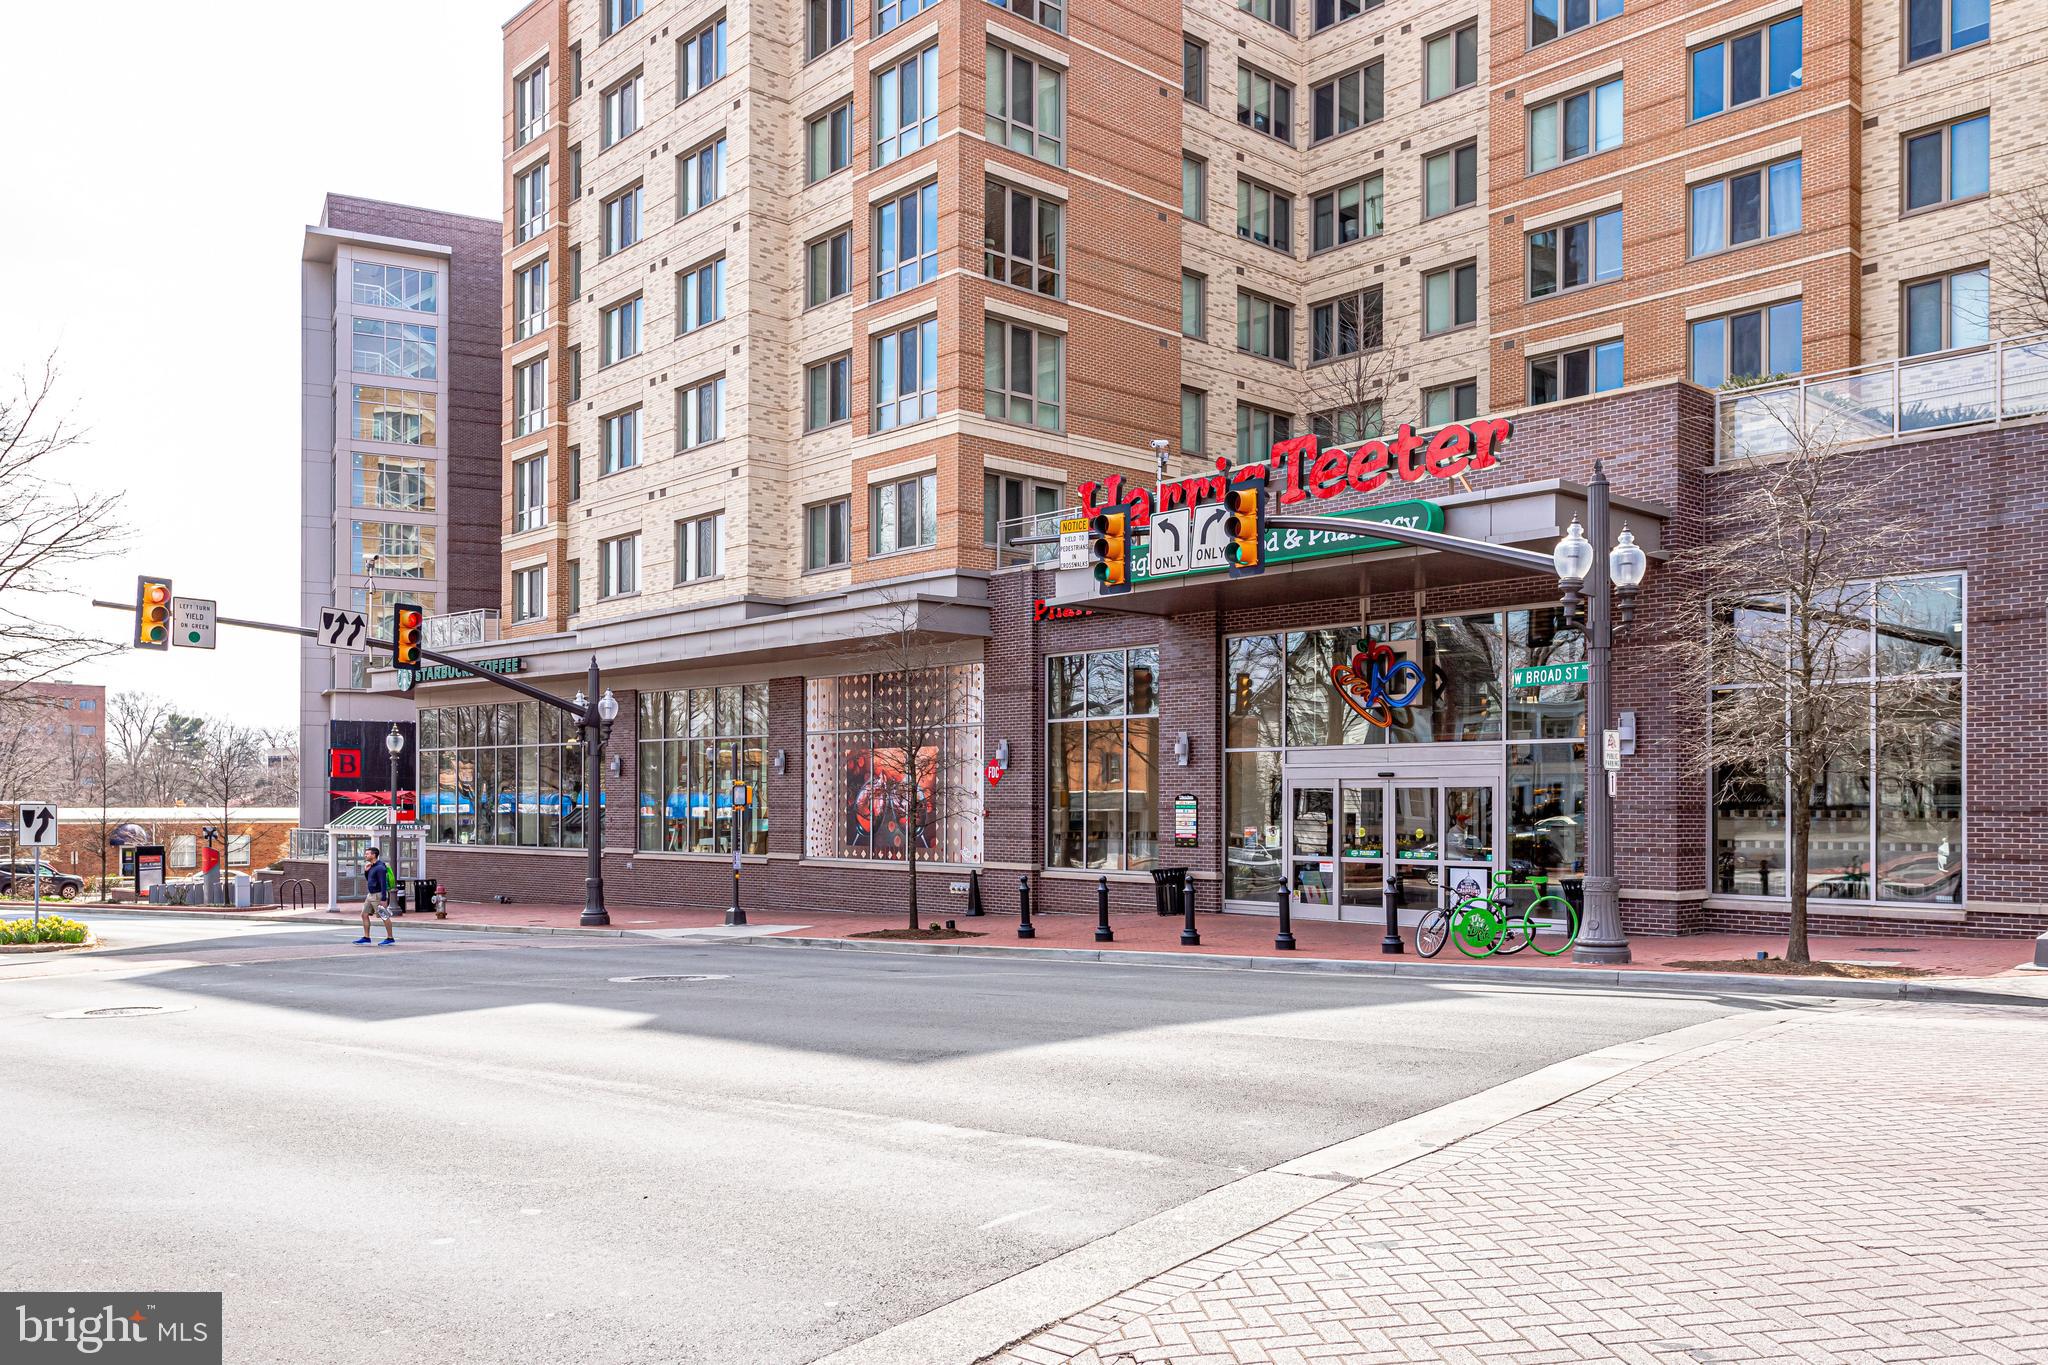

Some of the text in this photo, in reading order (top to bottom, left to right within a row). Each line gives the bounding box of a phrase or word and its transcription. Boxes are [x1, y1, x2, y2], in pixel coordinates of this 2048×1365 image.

[1271, 418, 1513, 504] Teeter
[1062, 520, 1087, 532] NOTICE
[1064, 535, 1077, 543] YIELD
[1284, 528, 1304, 550] &
[1060, 543, 1089, 553] PEDESTRIANS
[1196, 546, 1226, 561] ONLY
[1155, 554, 1184, 570] ONLY
[185, 612, 204, 621] YIELD
[1514, 672, 1523, 685] W
[1526, 668, 1562, 684] BROAD
[1565, 666, 1579, 680] ST
[340, 753, 357, 774] B
[988, 766, 1000, 779] FDC
